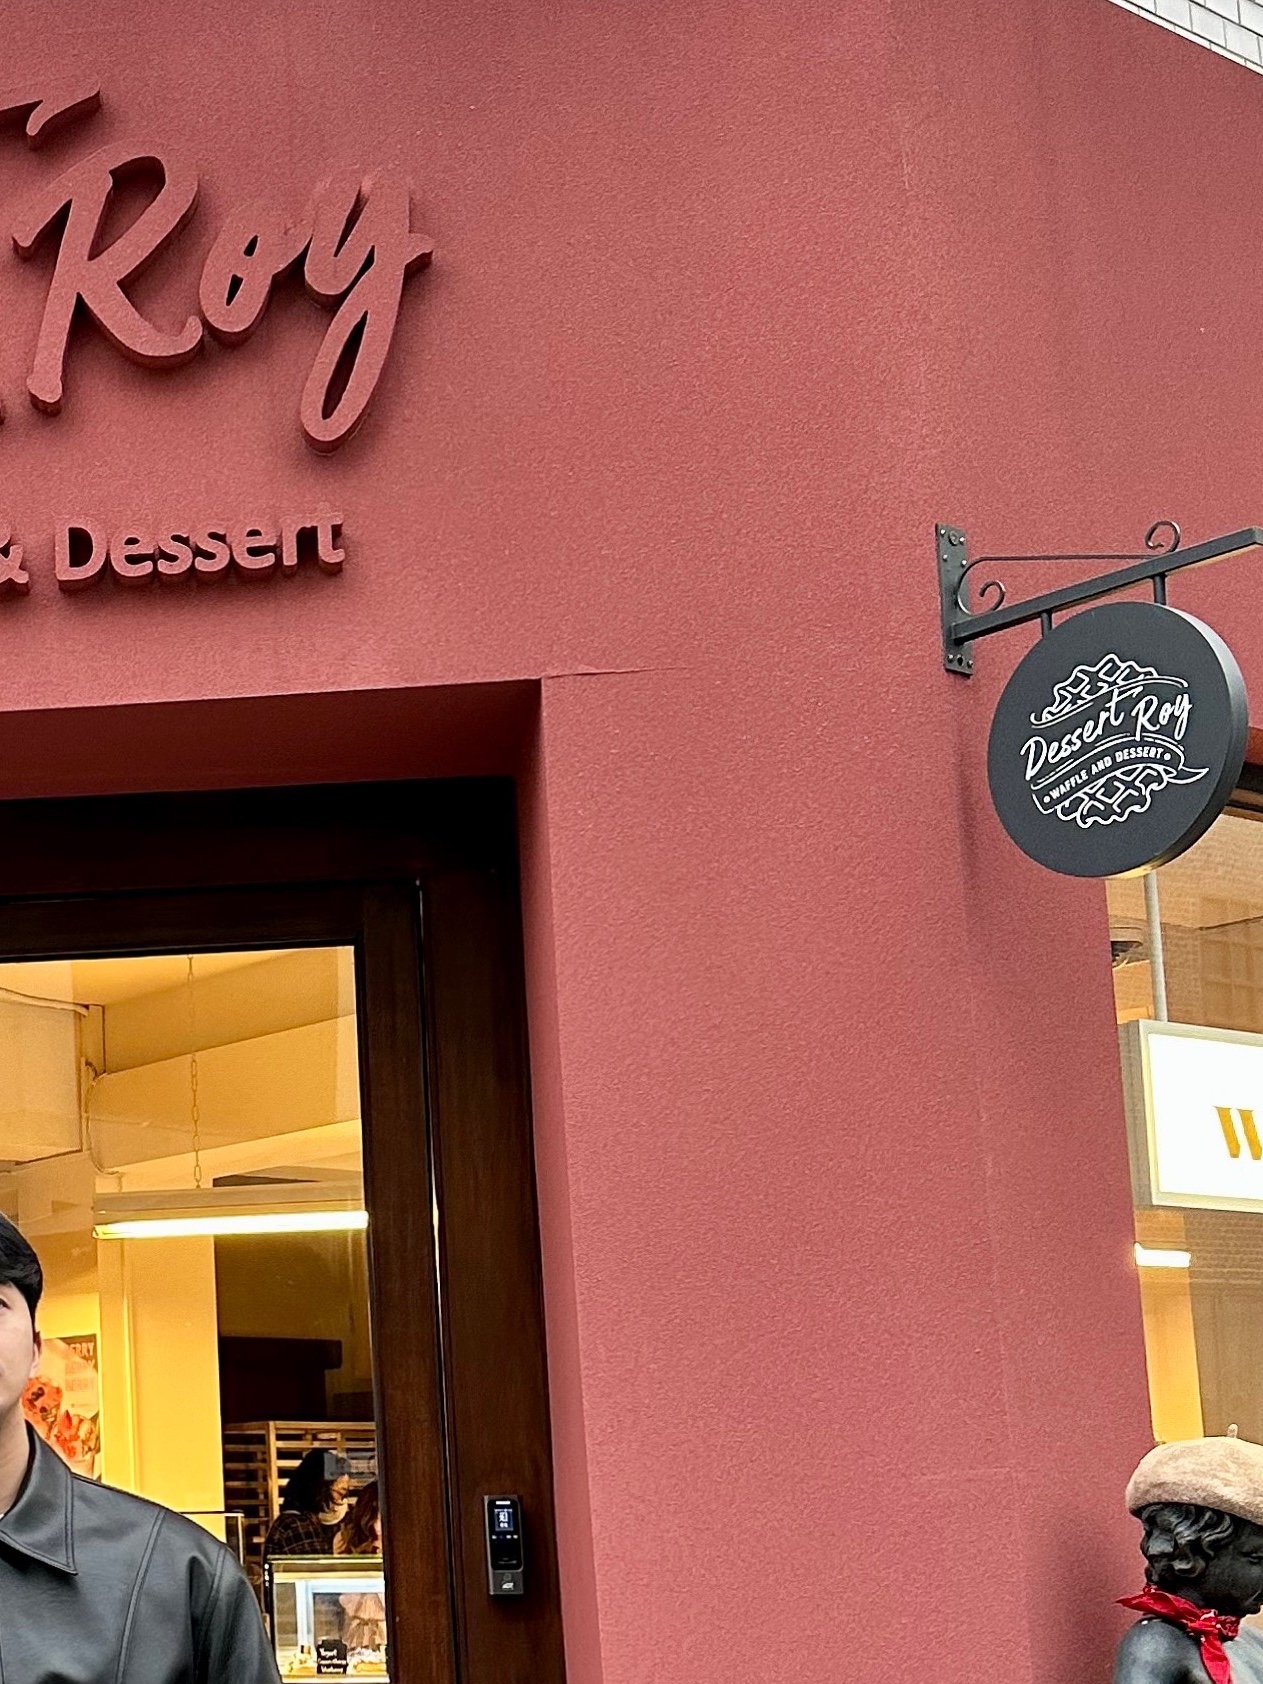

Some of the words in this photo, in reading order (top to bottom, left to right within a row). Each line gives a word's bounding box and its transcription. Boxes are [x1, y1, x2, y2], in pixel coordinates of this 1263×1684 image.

[12, 138, 434, 453] Roy
[53, 511, 345, 586] Dessert
[1019, 686, 1144, 781] Dessert
[1130, 693, 1193, 742] Roy
[1048, 769, 1089, 800] WAFFLE
[1091, 756, 1113, 775] AND
[1114, 746, 1165, 763] DESSERT
